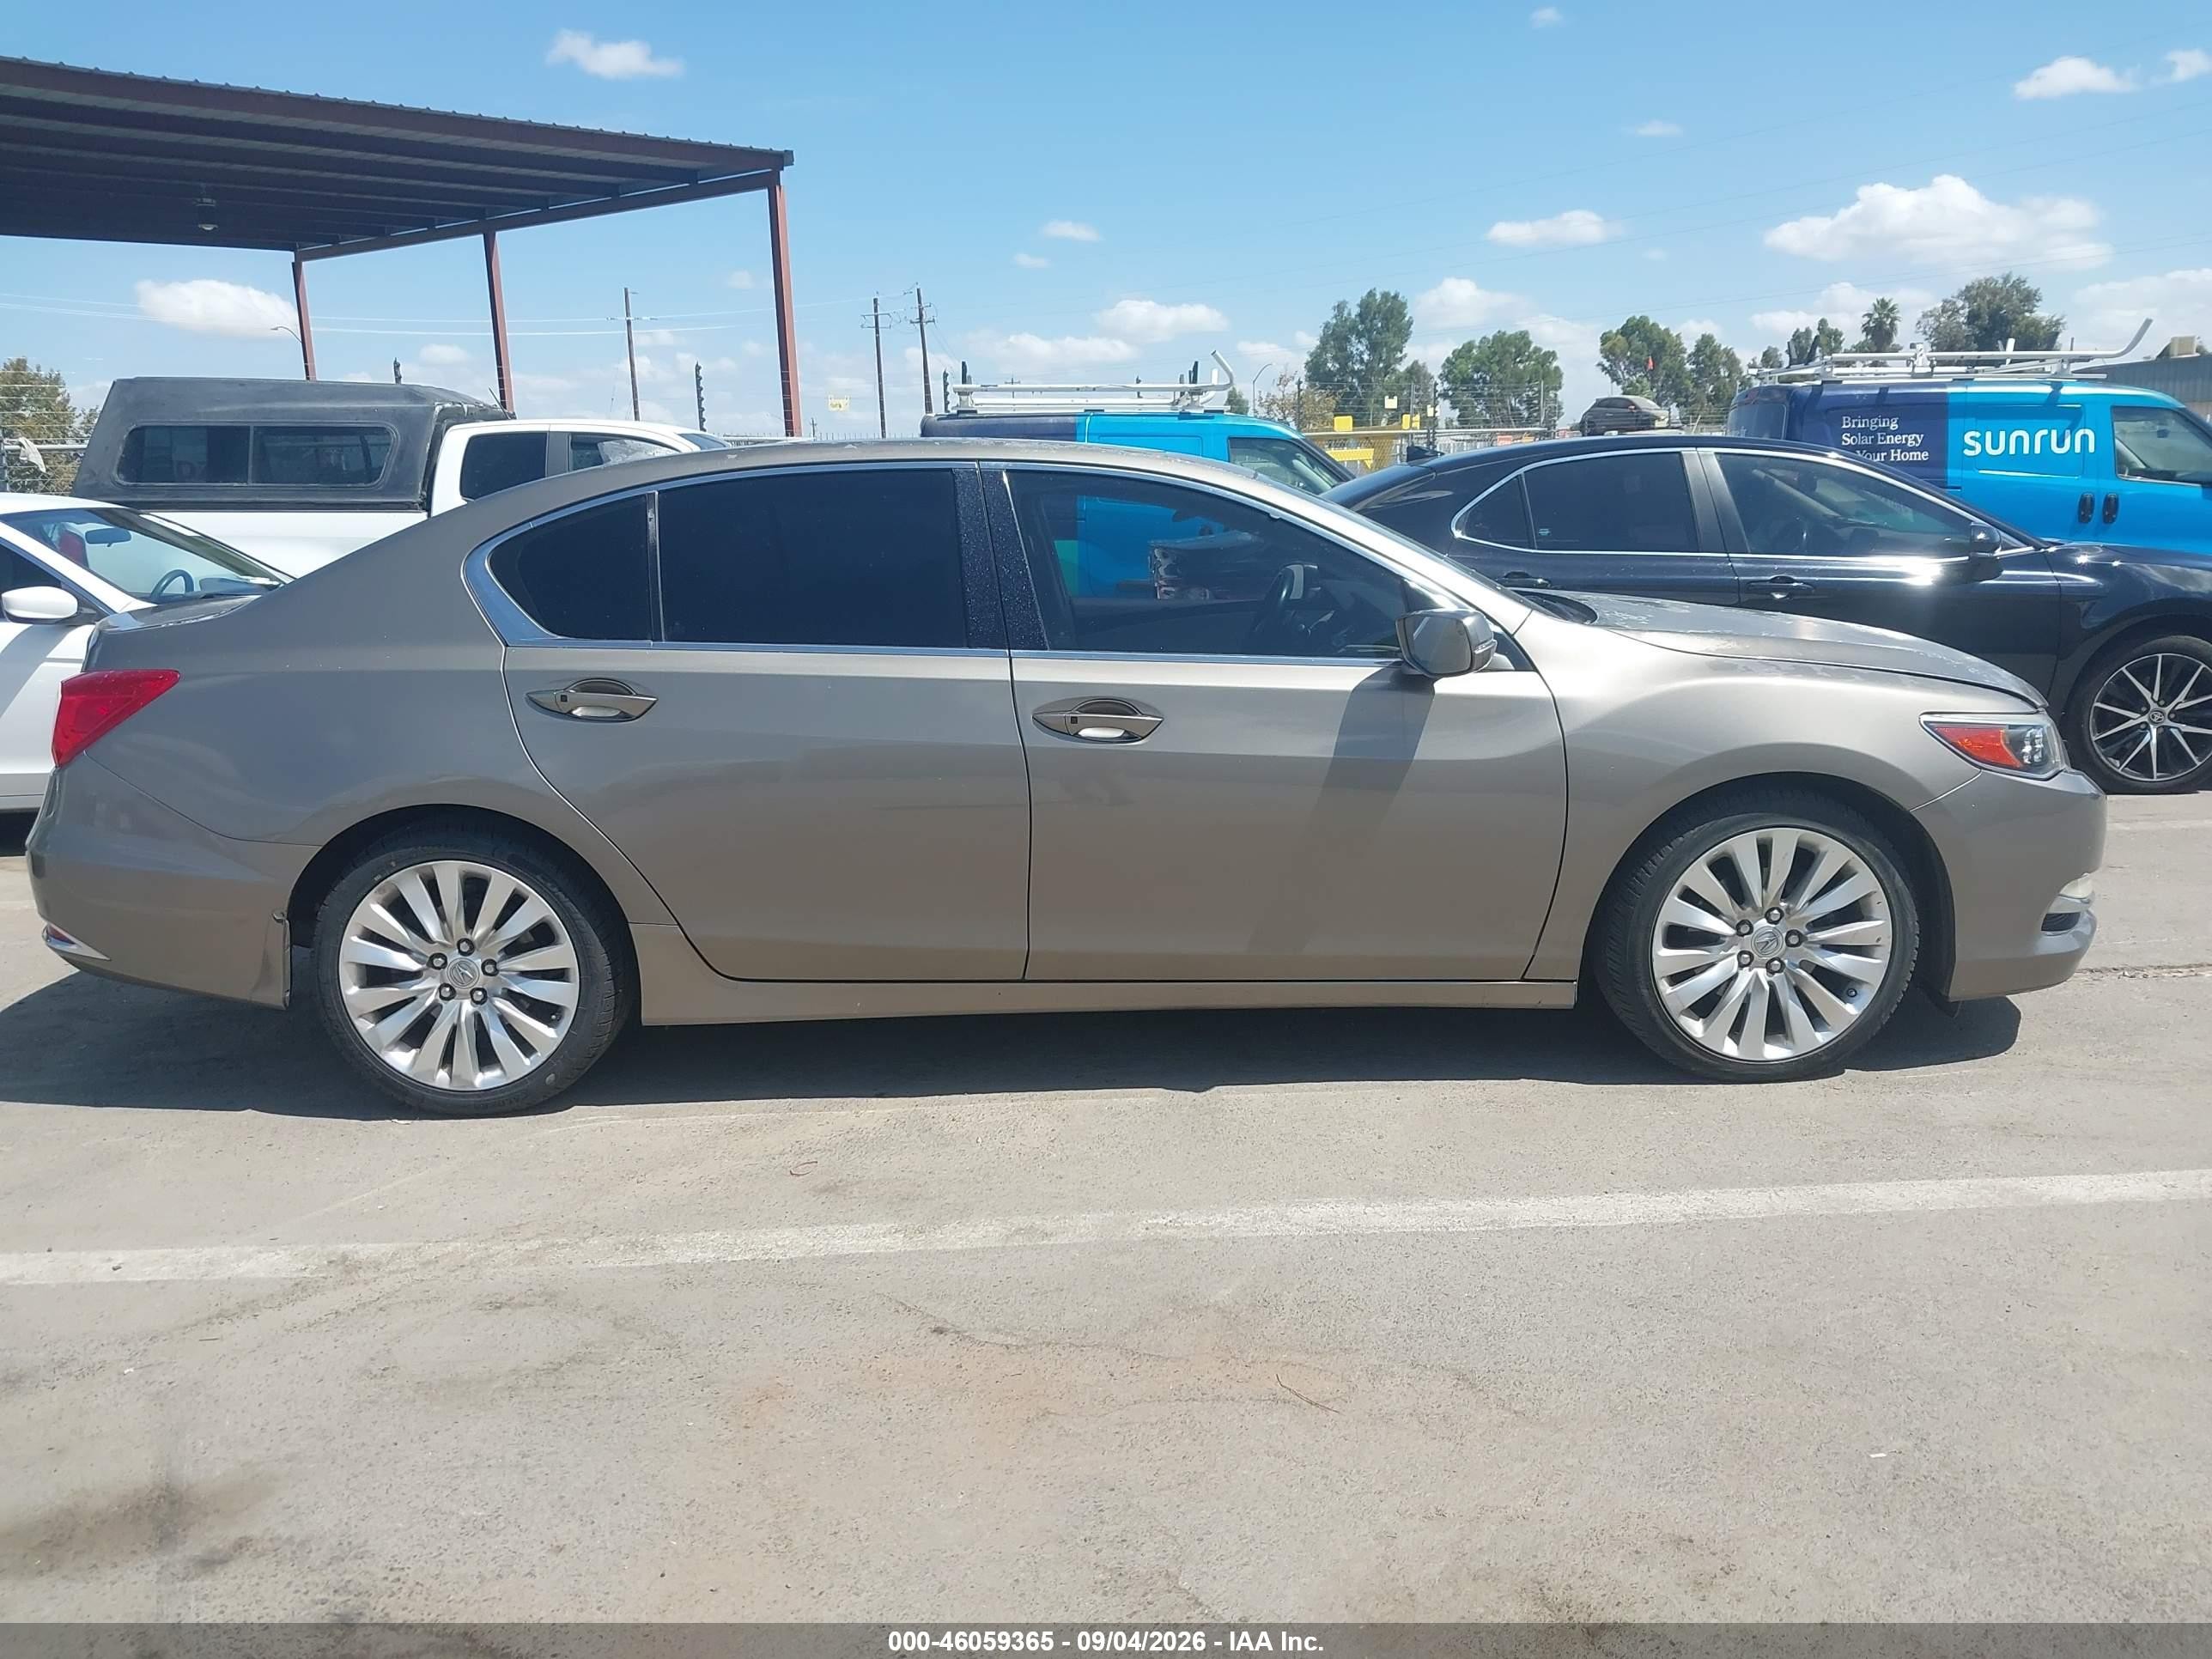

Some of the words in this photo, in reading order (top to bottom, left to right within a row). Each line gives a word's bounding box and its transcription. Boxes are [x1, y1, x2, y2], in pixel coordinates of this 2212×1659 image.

[1841, 415, 1899, 431] Bringing
[1841, 432, 1875, 446] Solar
[1877, 432, 1924, 447] Energy
[1963, 428, 2095, 457] sunrun
[1890, 448, 1929, 461] Home
